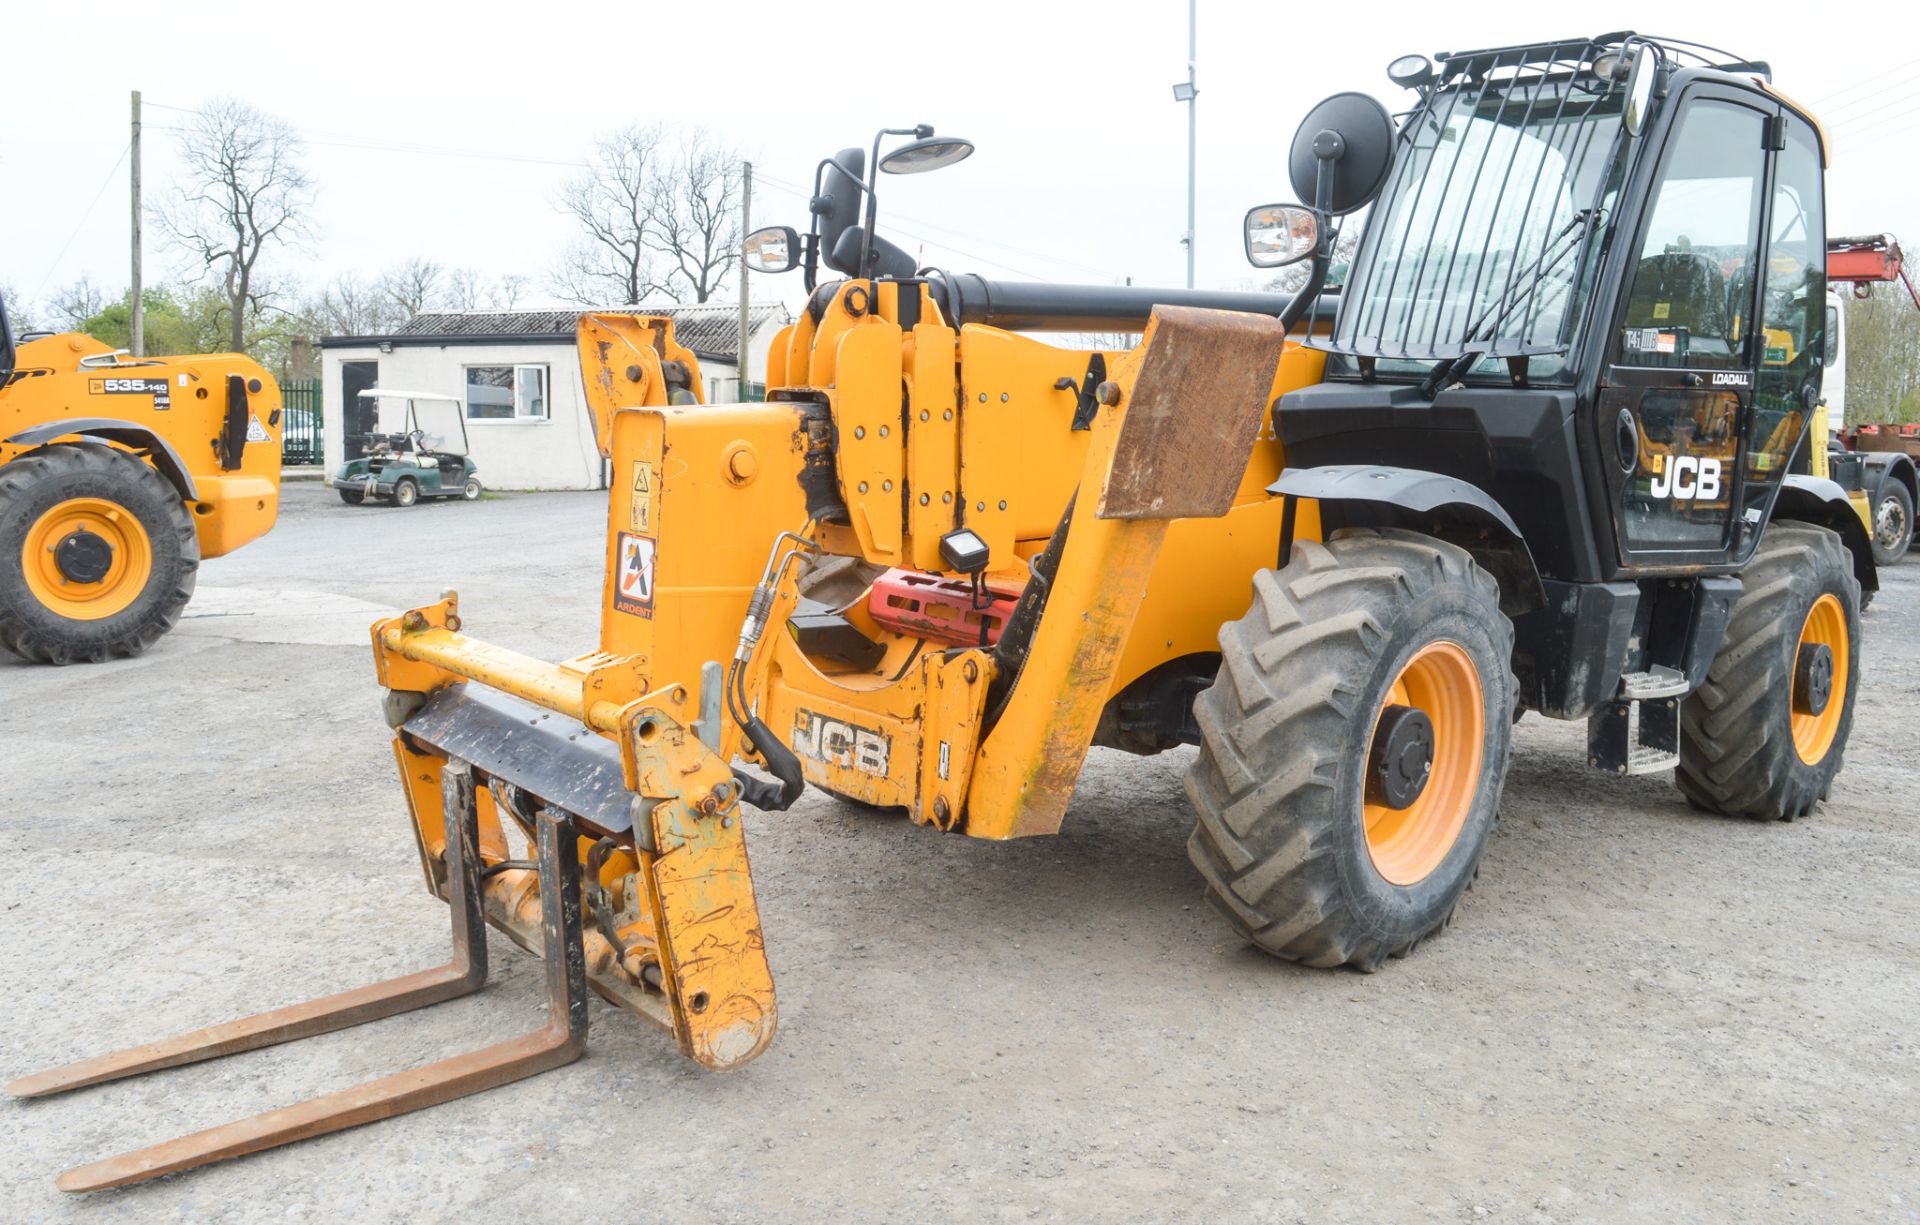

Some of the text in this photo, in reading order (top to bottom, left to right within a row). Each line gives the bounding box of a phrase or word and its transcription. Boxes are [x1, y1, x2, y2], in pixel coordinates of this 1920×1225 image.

[105, 379, 167, 391] 535-140
[1712, 373, 1748, 385] LOADALL
[1650, 455, 1721, 499] JCB
[617, 601, 652, 618] ARDENT
[794, 714, 888, 778] JCB
